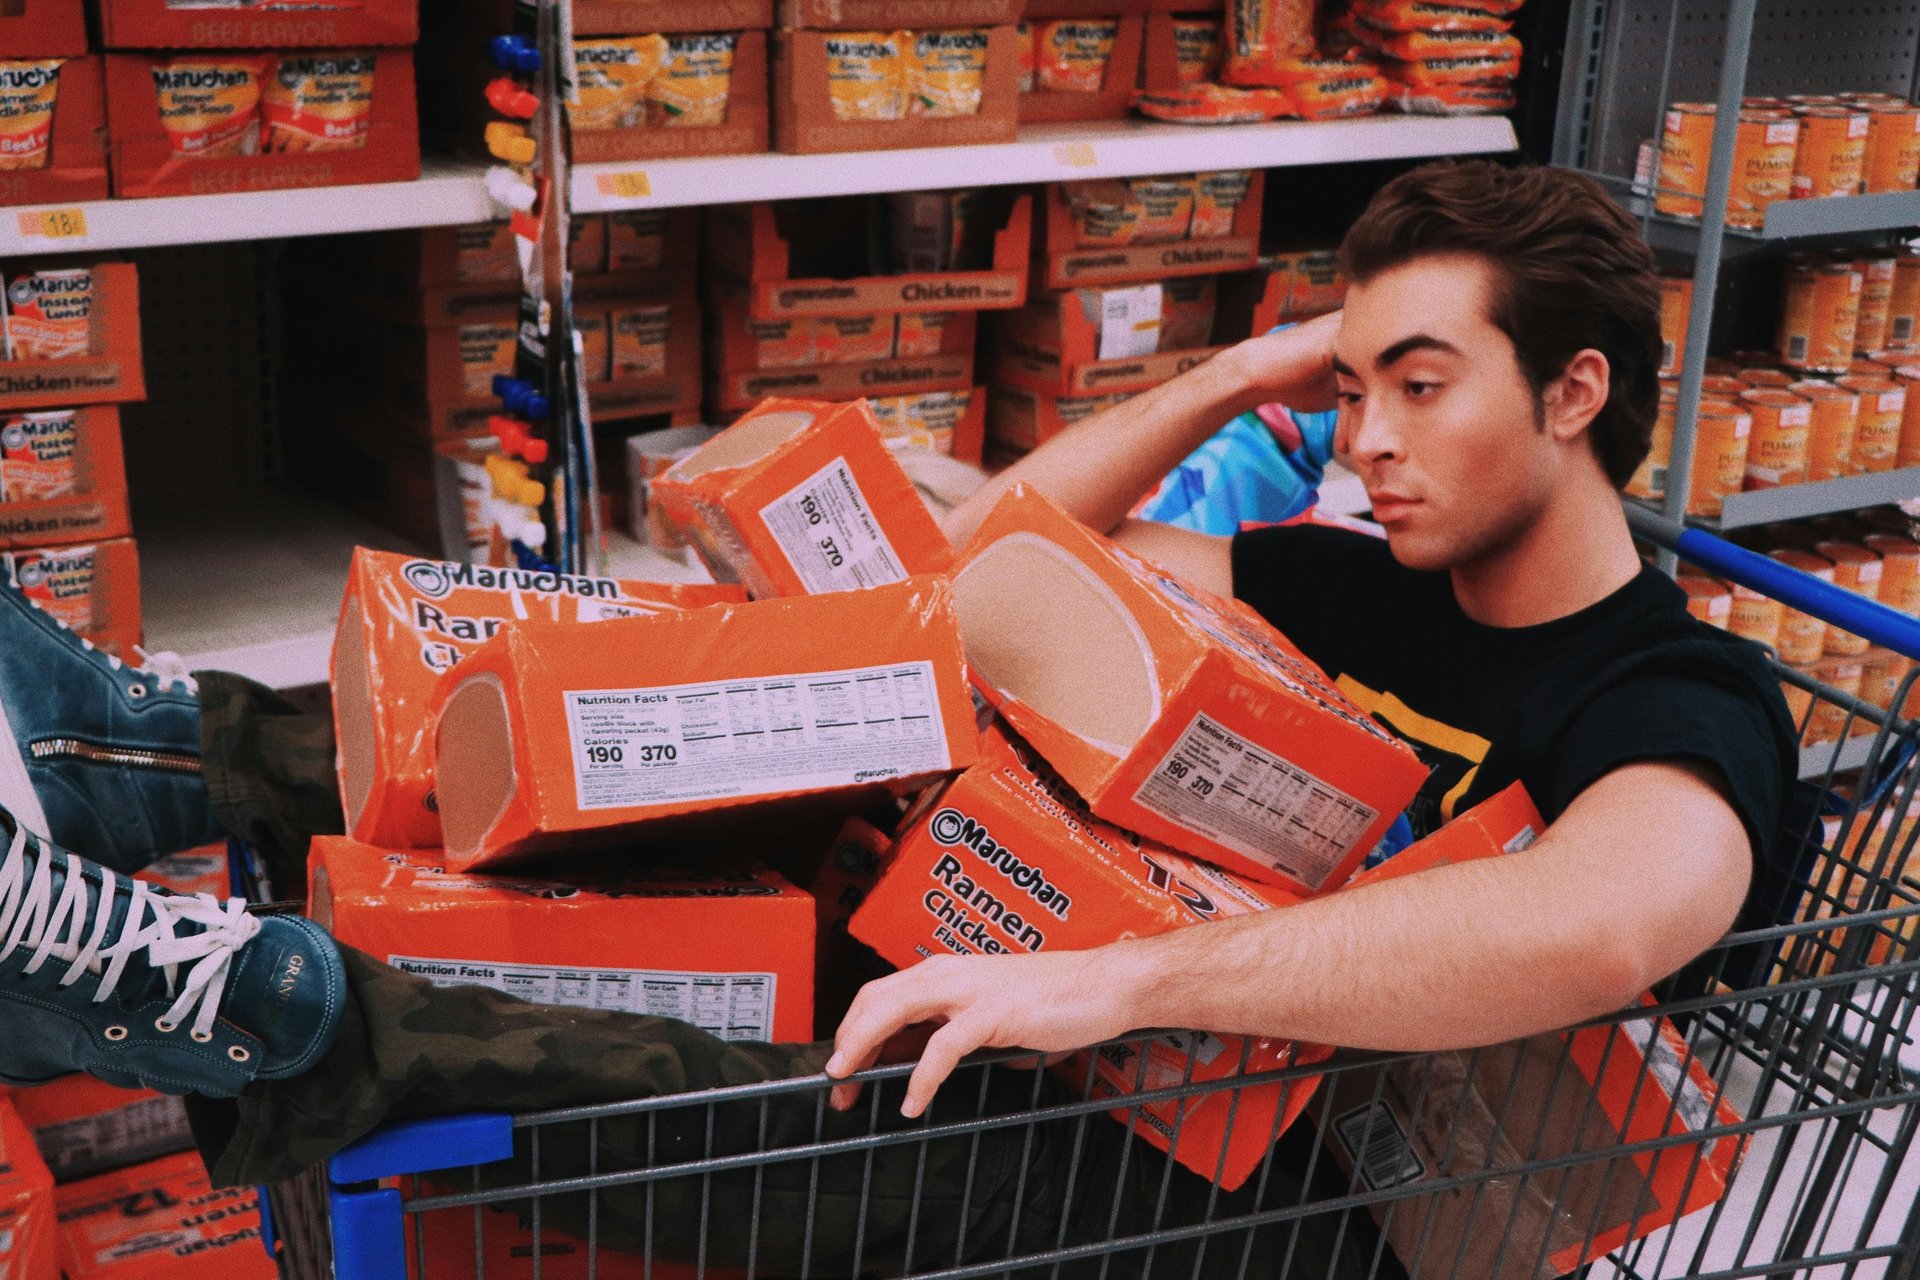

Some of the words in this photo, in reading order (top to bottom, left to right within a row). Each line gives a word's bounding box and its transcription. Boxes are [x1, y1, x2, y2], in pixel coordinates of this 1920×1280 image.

[1161, 249, 1224, 267] Chicken
[902, 282, 981, 301] Chicken
[860, 367, 935, 385] Chicken
[22, 418, 76, 436] Maruc
[30, 437, 76, 451] Insta
[38, 449, 73, 462] Lunc
[837, 468, 862, 511] Nutrition
[859, 512, 878, 541] Facts
[0, 517, 59, 534] hicken
[800, 494, 822, 526] 190
[821, 536, 844, 567] 370
[39, 555, 94, 574] Maruc
[442, 564, 618, 599] Maruchan
[54, 586, 89, 599] Lunc
[577, 696, 631, 706] Nutrition
[634, 693, 669, 704] Facts
[583, 737, 629, 746] Calories
[1196, 719, 1224, 742] Nutrition
[1225, 738, 1244, 752] Facts
[587, 746, 623, 764] 190
[640, 744, 677, 762] 370
[1173, 752, 1197, 770] Calories
[861, 767, 898, 778] Maruchan
[1166, 759, 1188, 779] 190
[1190, 775, 1214, 796] 370
[961, 816, 1072, 917] Maruchan
[1138, 851, 1218, 921] 12
[931, 853, 1044, 952] Ramen
[400, 962, 456, 976] Nutrition
[459, 965, 496, 979] Facts
[503, 977, 521, 985] Total
[643, 984, 660, 992] Total
[121, 1188, 179, 1219] 12
